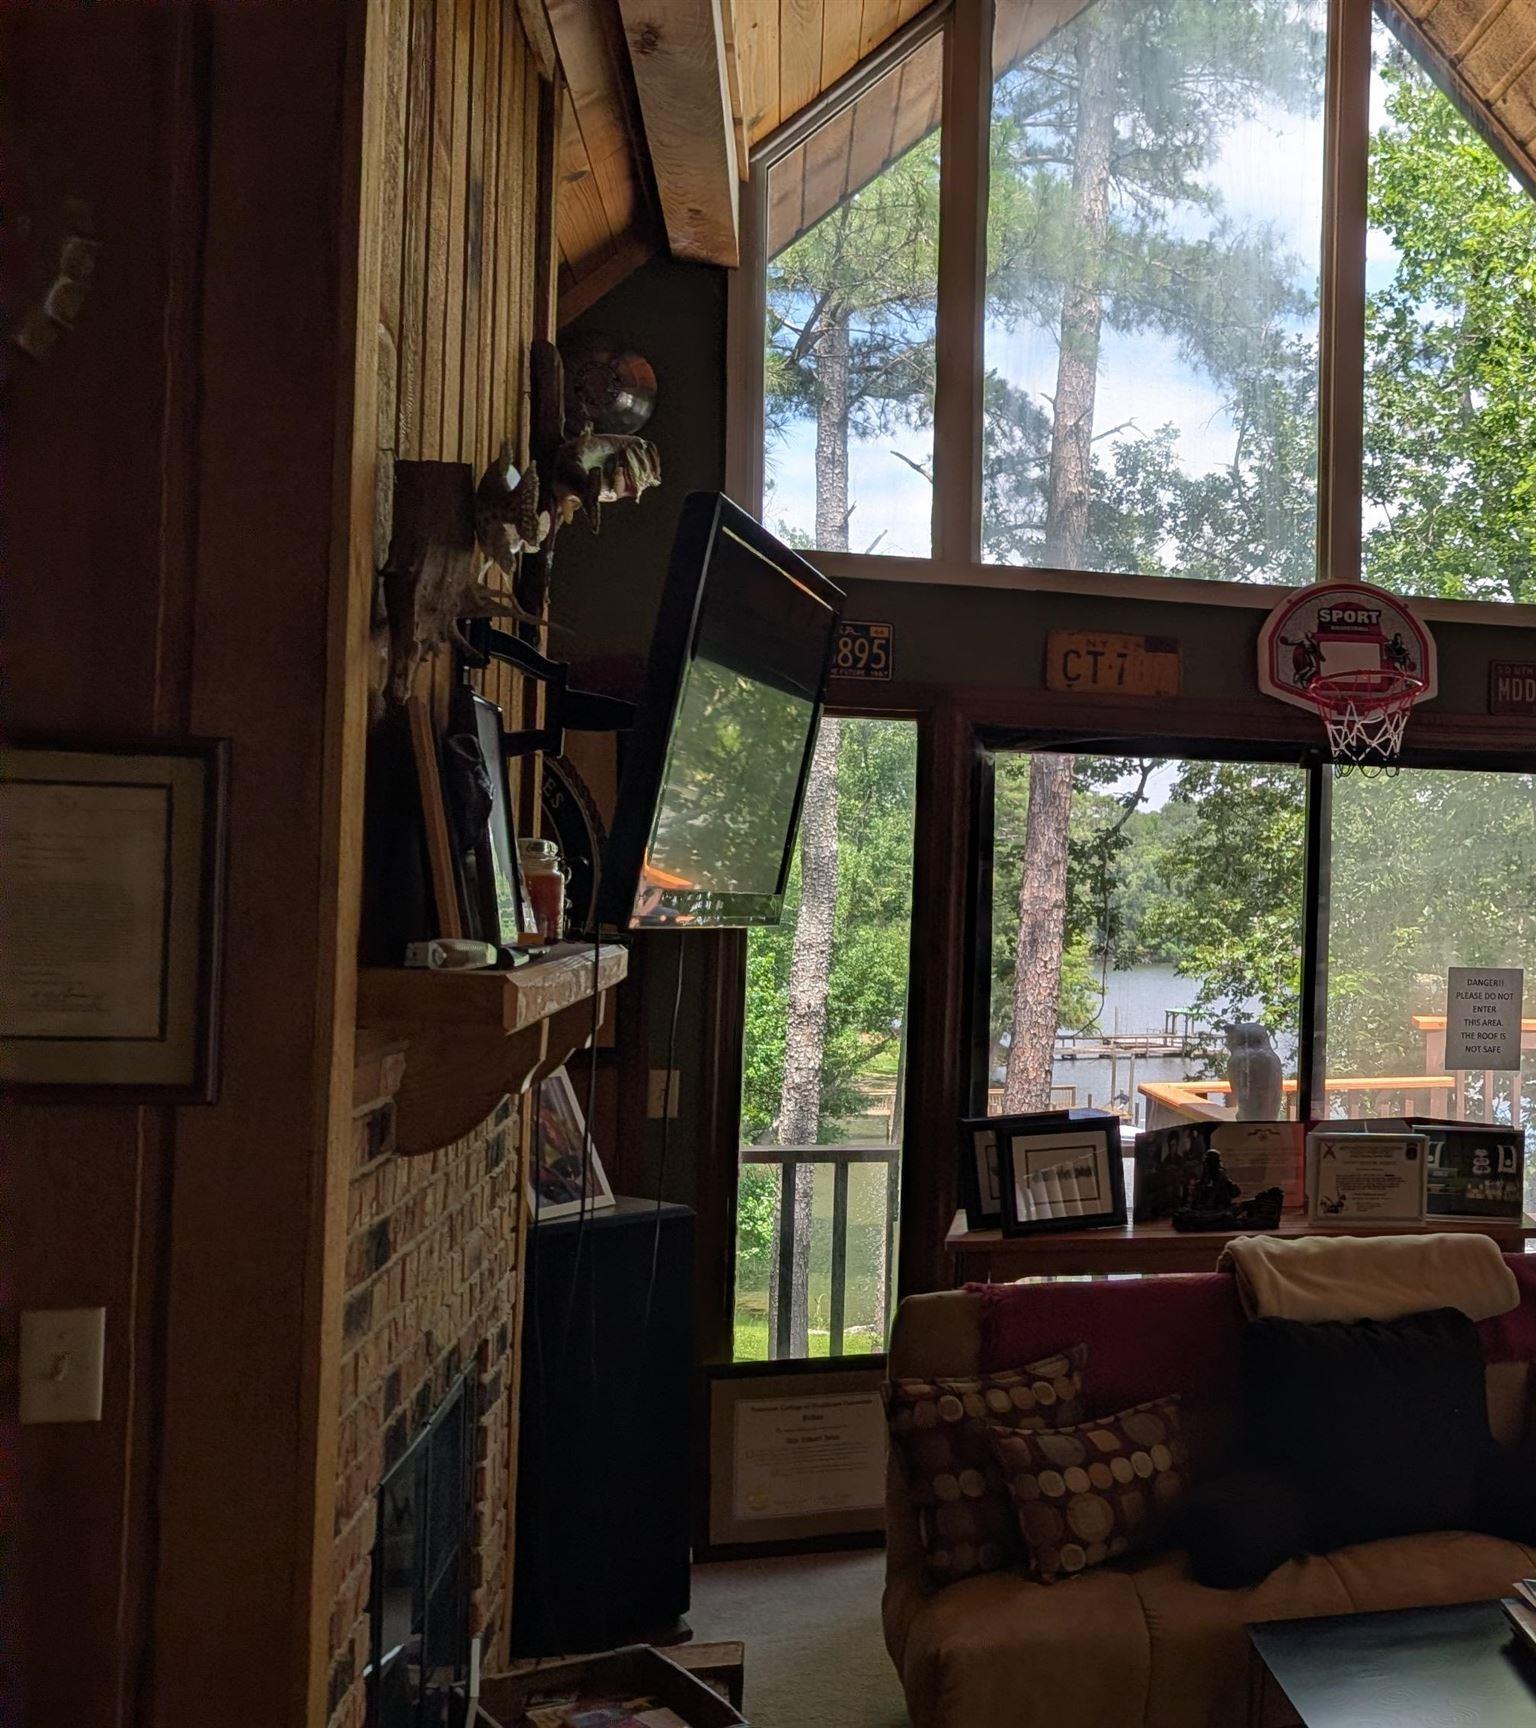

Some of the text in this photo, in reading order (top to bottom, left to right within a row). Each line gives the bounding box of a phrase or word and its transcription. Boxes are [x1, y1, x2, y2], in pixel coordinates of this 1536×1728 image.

[1318, 608, 1381, 625] SPORT
[832, 637, 887, 669] 895
[1496, 664, 1534, 675] SOUTH
[1498, 676, 1536, 703] MDD
[1467, 979, 1504, 987] DANGER!!
[1456, 992, 1514, 1001] PLEASE DO NOT
[1472, 1005, 1497, 1013] ENTER
[1464, 1018, 1481, 1027] THIS
[1461, 1032, 1506, 1040] THE ROOF IS
[1465, 1045, 1481, 1053] NOT
